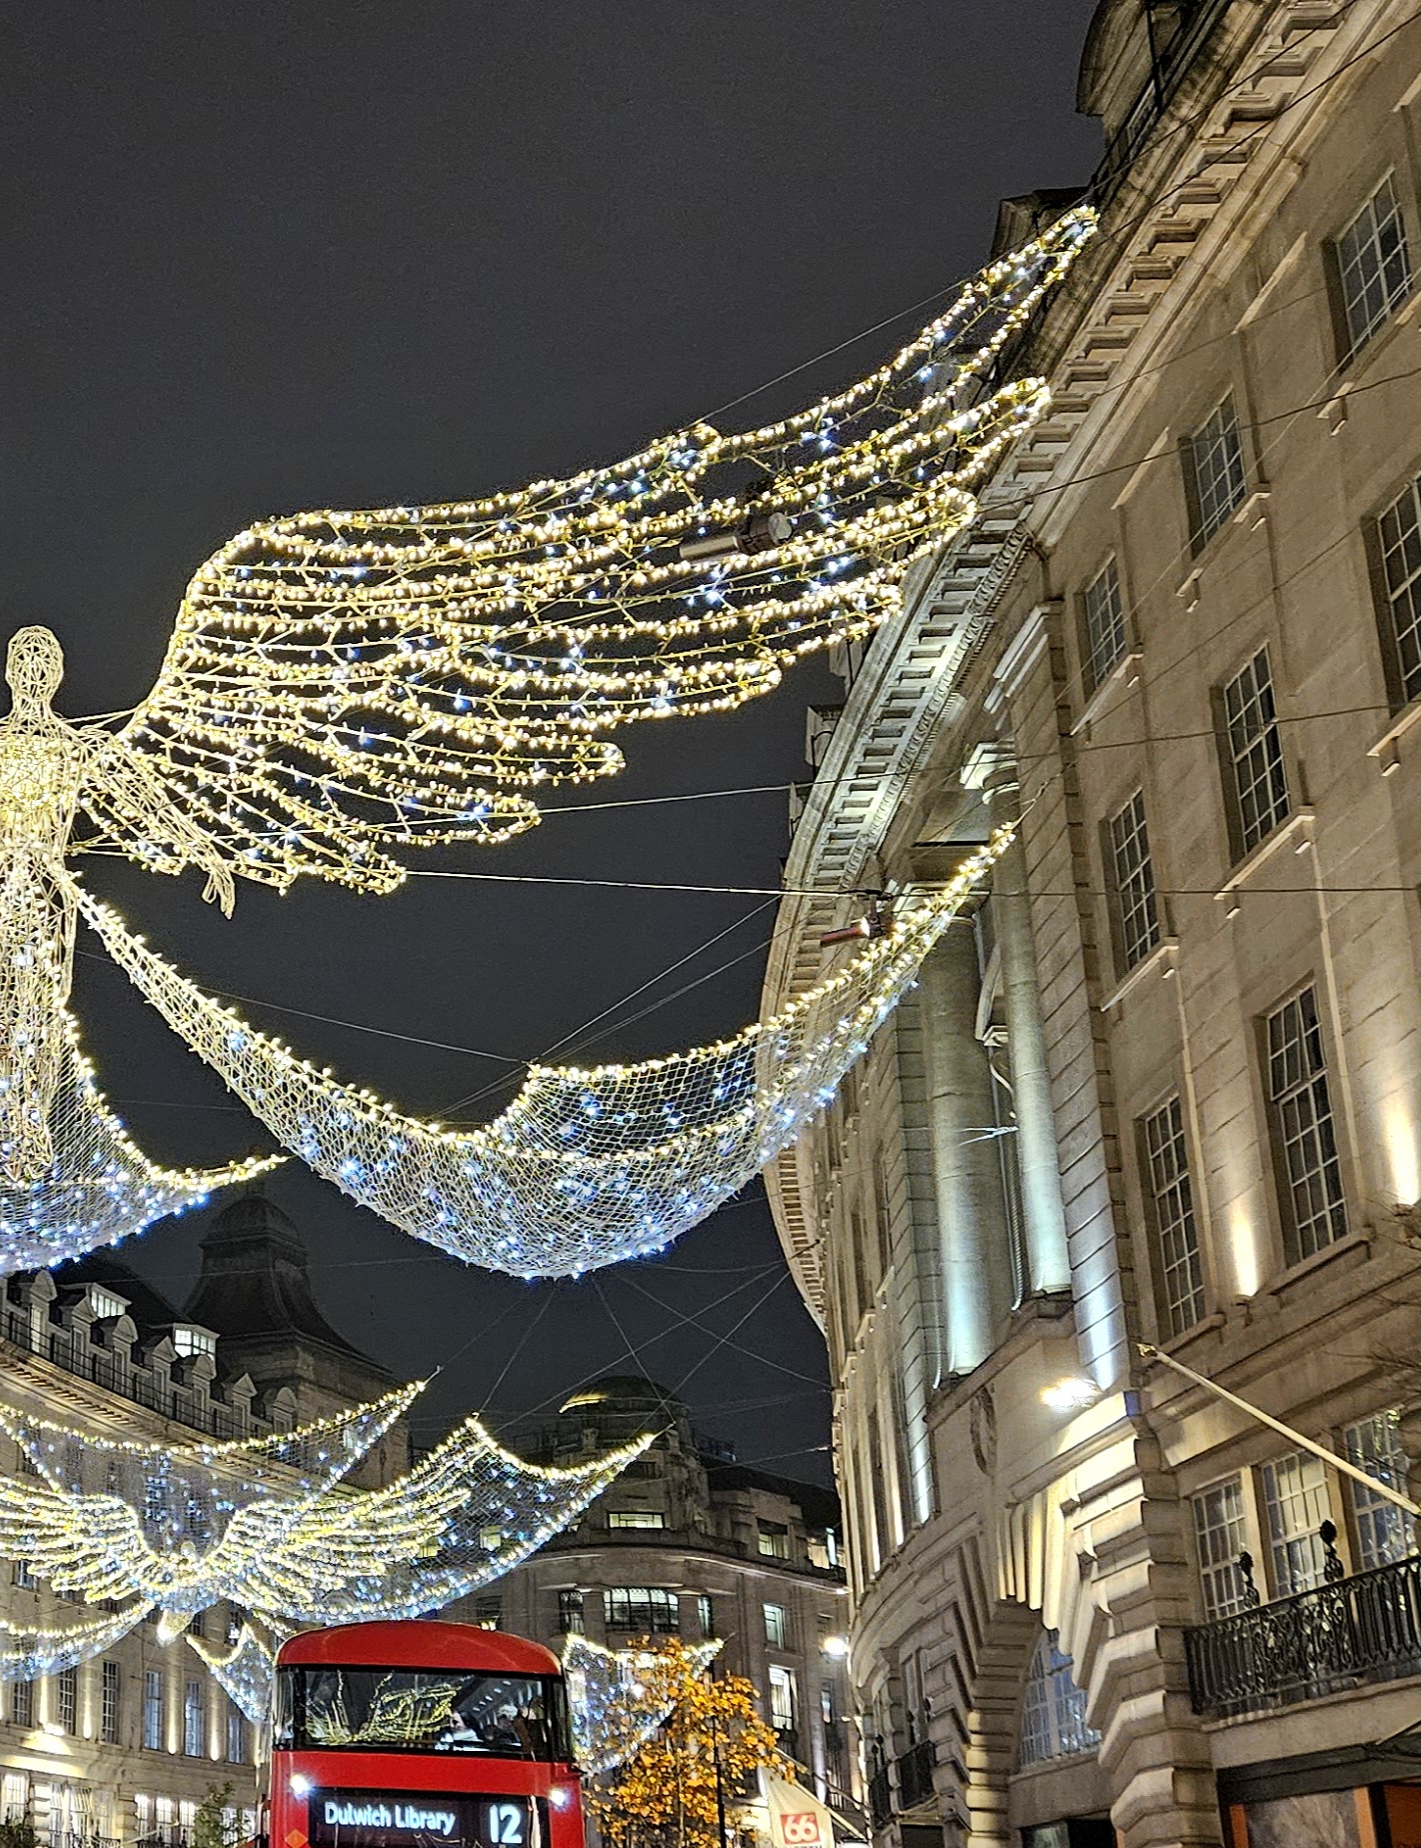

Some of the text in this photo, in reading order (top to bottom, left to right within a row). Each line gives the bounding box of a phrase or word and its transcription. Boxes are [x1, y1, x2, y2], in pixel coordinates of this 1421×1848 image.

[324, 1802, 456, 1836] Dulwich Library
[489, 1804, 523, 1844] 12
